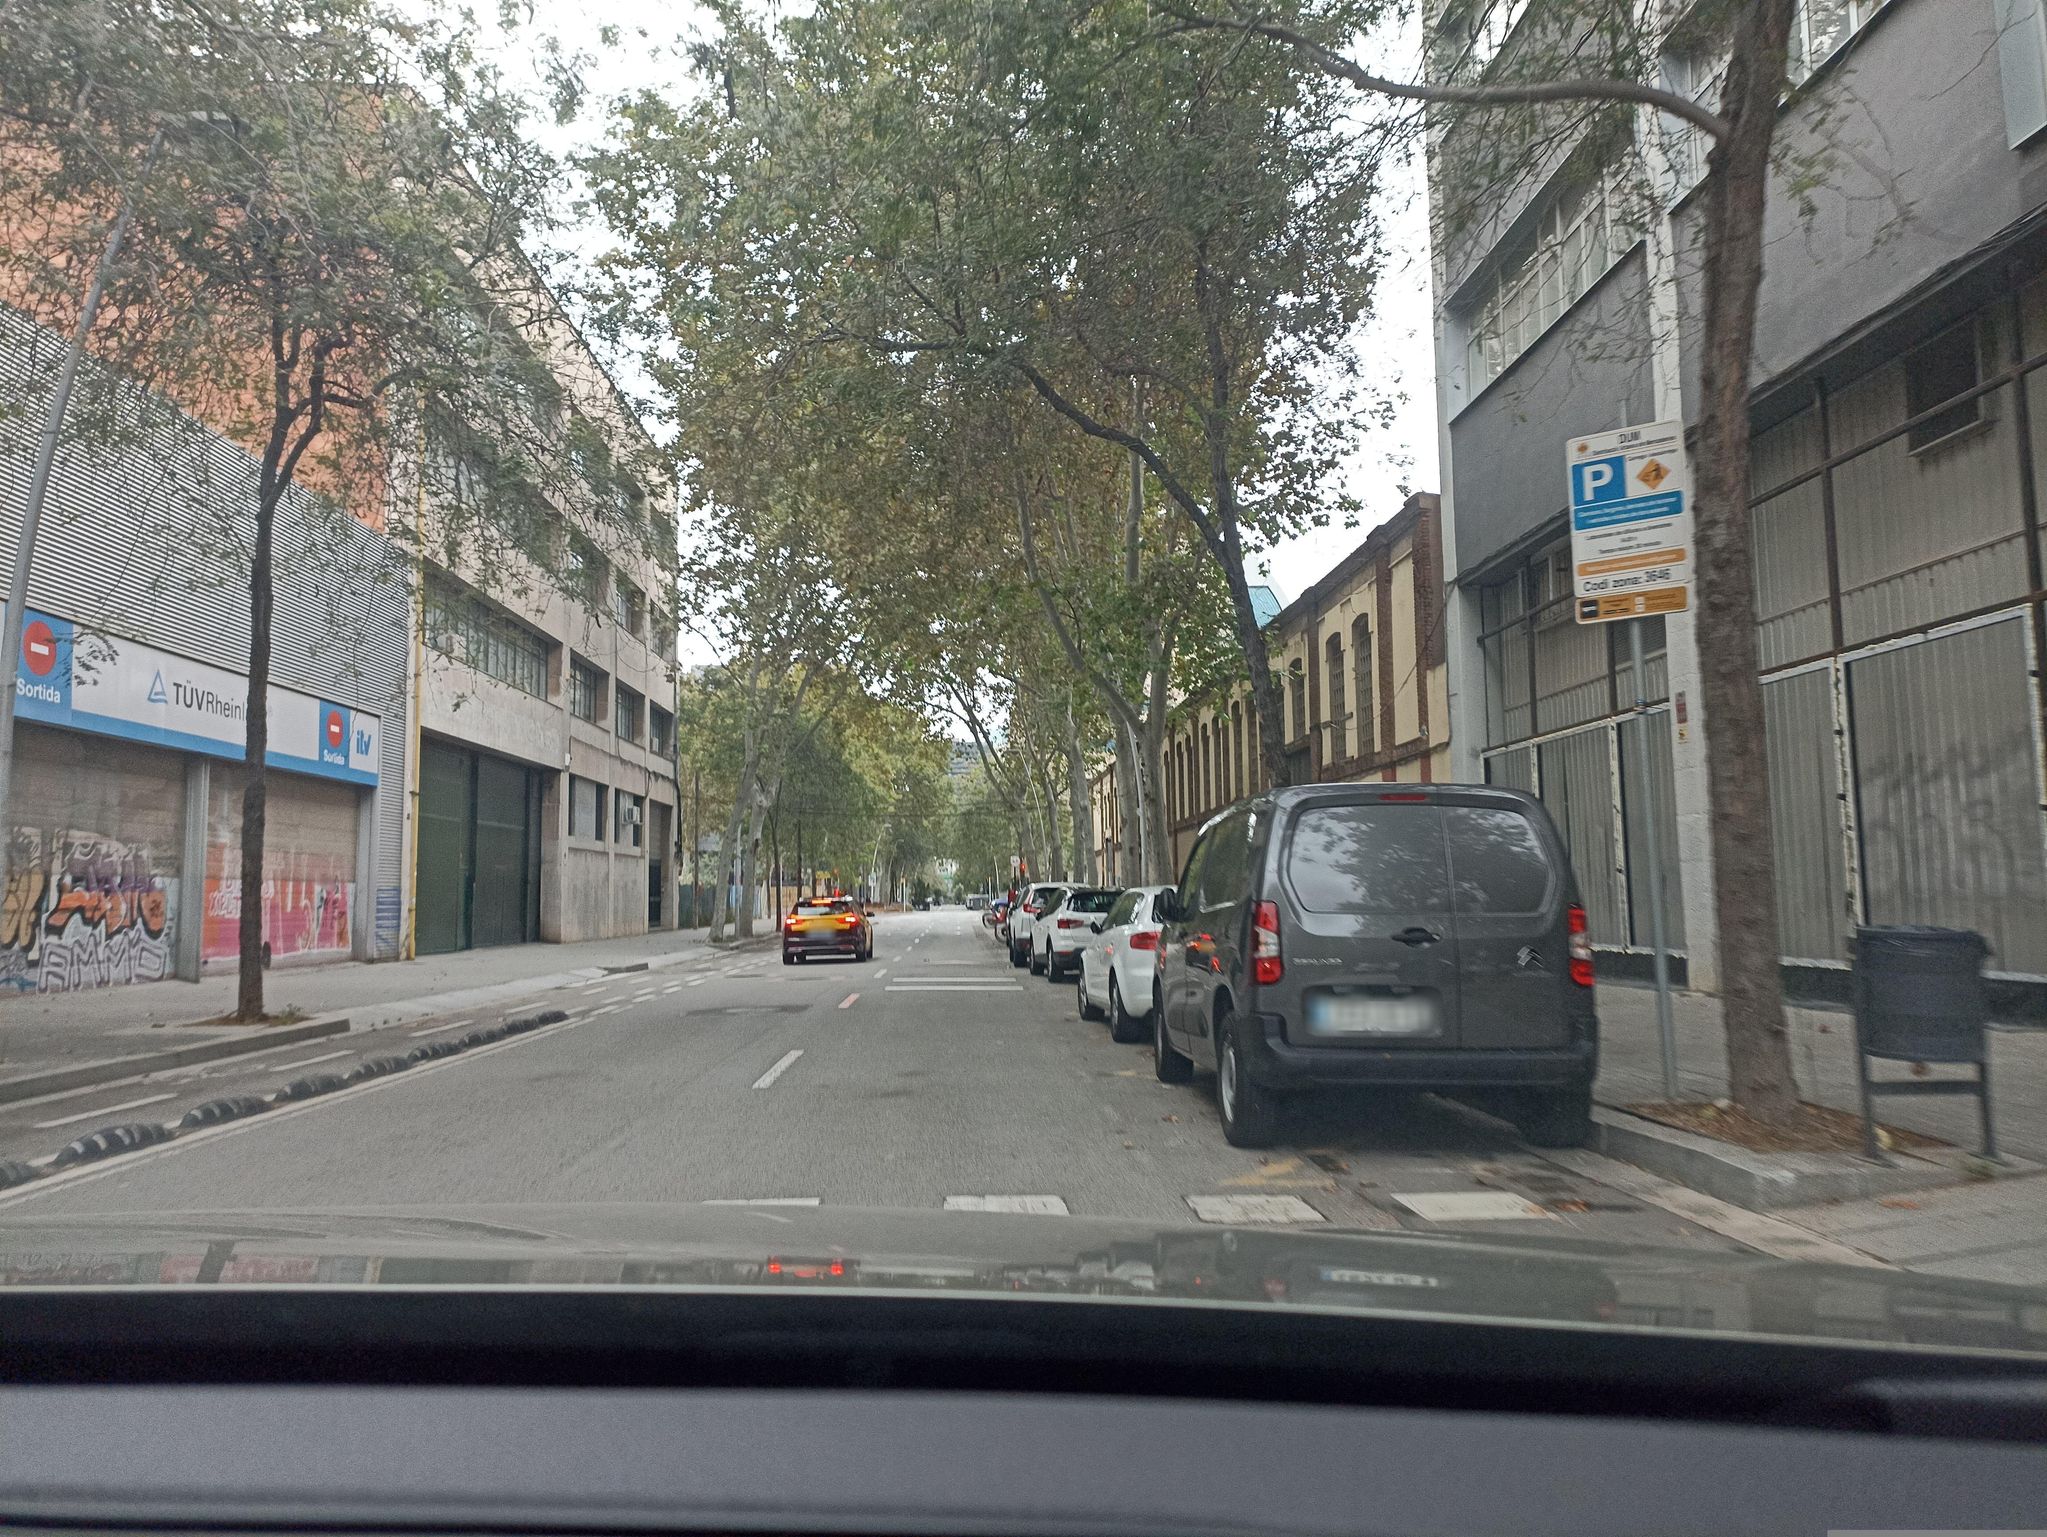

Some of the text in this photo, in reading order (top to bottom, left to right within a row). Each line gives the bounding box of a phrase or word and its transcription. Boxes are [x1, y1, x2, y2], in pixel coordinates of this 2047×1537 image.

[1583, 463, 1614, 501] P
[1583, 579, 1608, 592] Codi
[16, 677, 61, 704] Sortida
[356, 729, 372, 757] itv
[323, 749, 346, 766] Sortida
